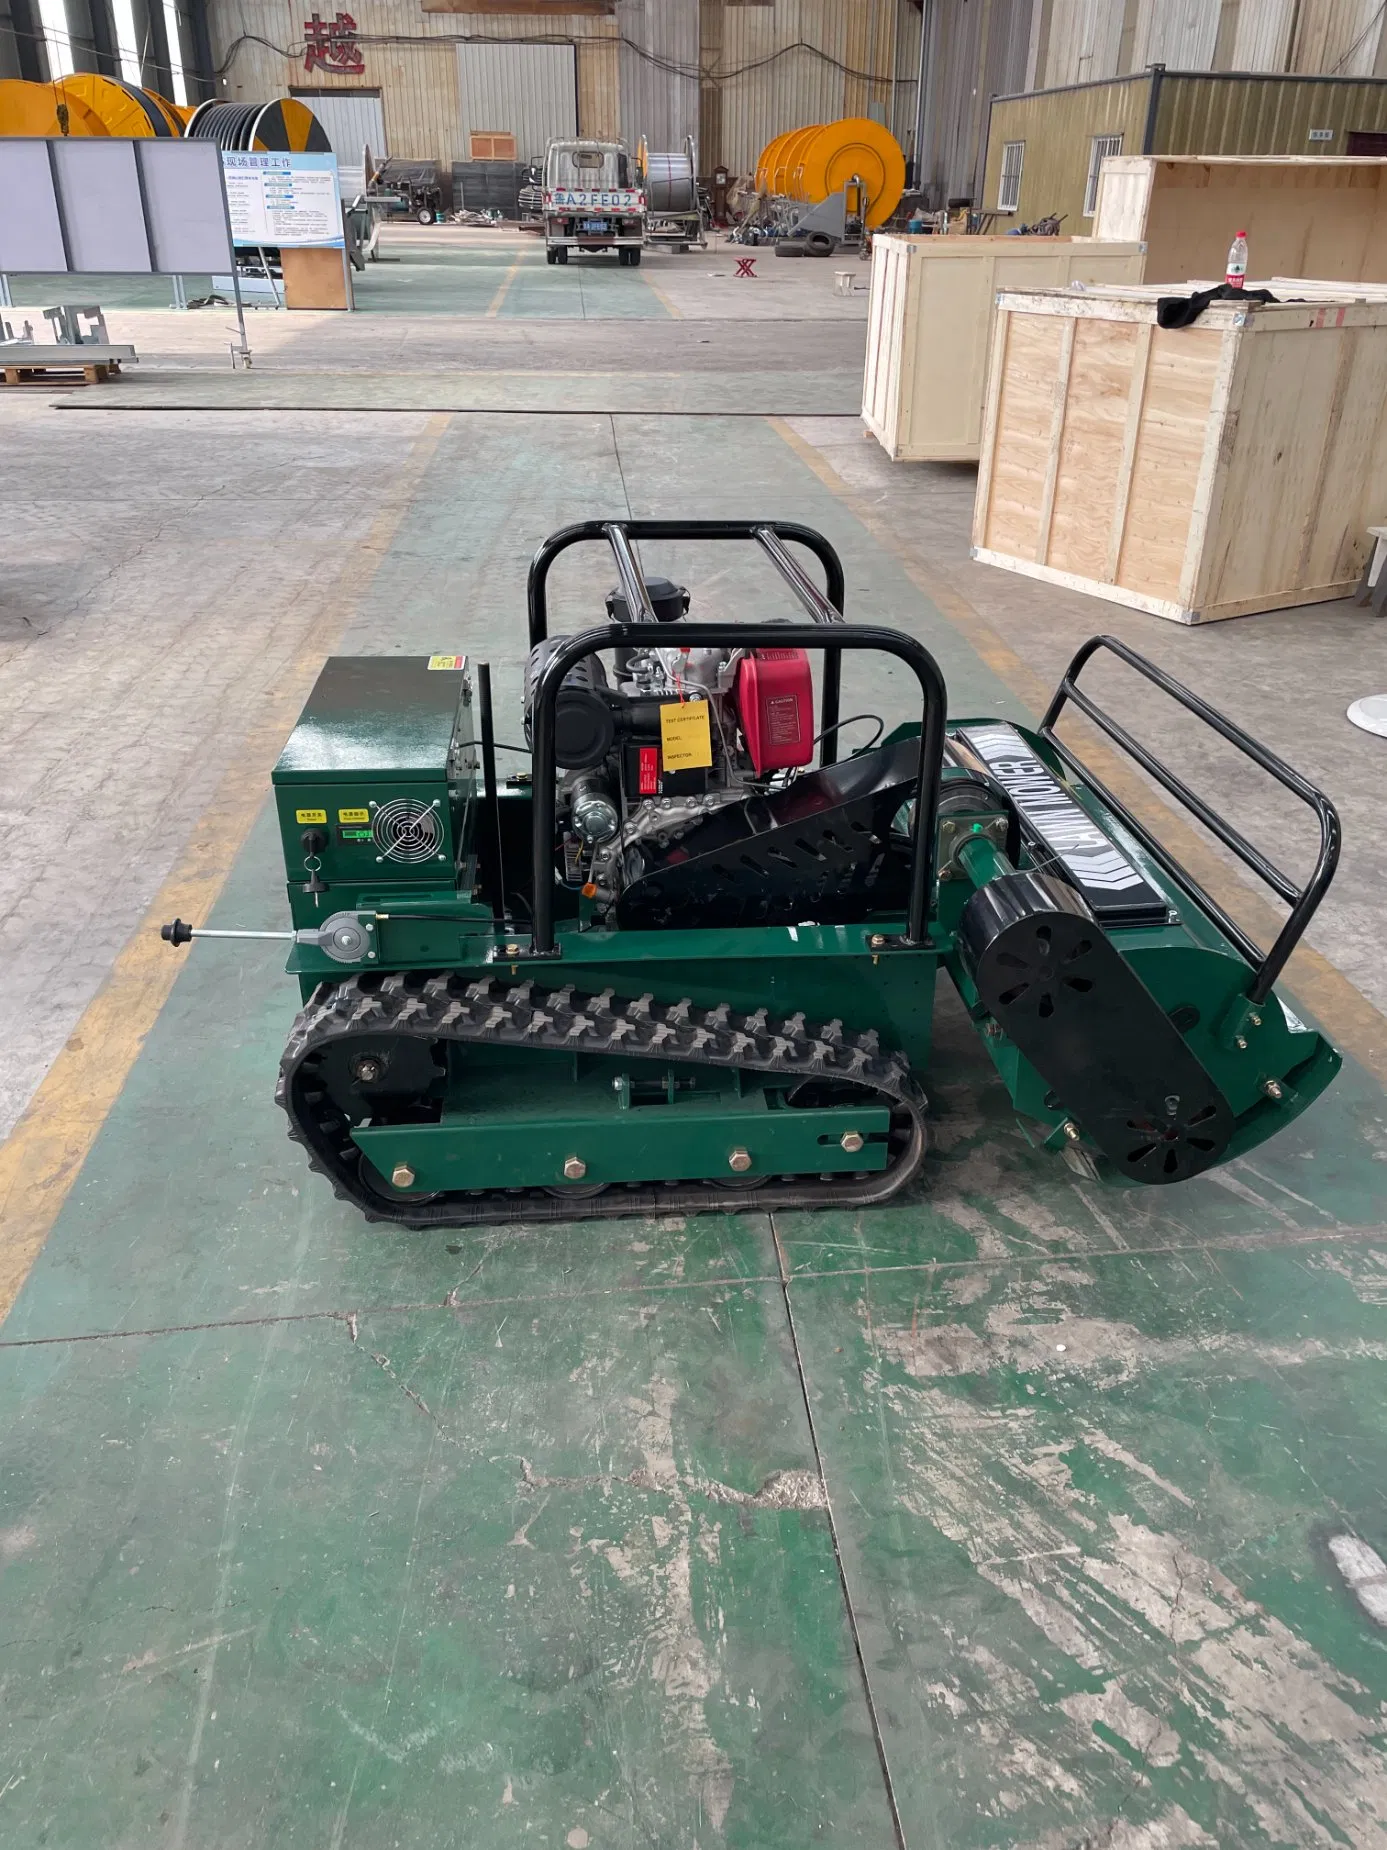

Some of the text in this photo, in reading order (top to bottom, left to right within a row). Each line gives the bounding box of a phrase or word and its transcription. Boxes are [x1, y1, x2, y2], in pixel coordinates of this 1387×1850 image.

[304, 13, 365, 74] 越
[222, 156, 291, 168] 现场管理工作
[988, 759, 1109, 851] LAWN MOWER
